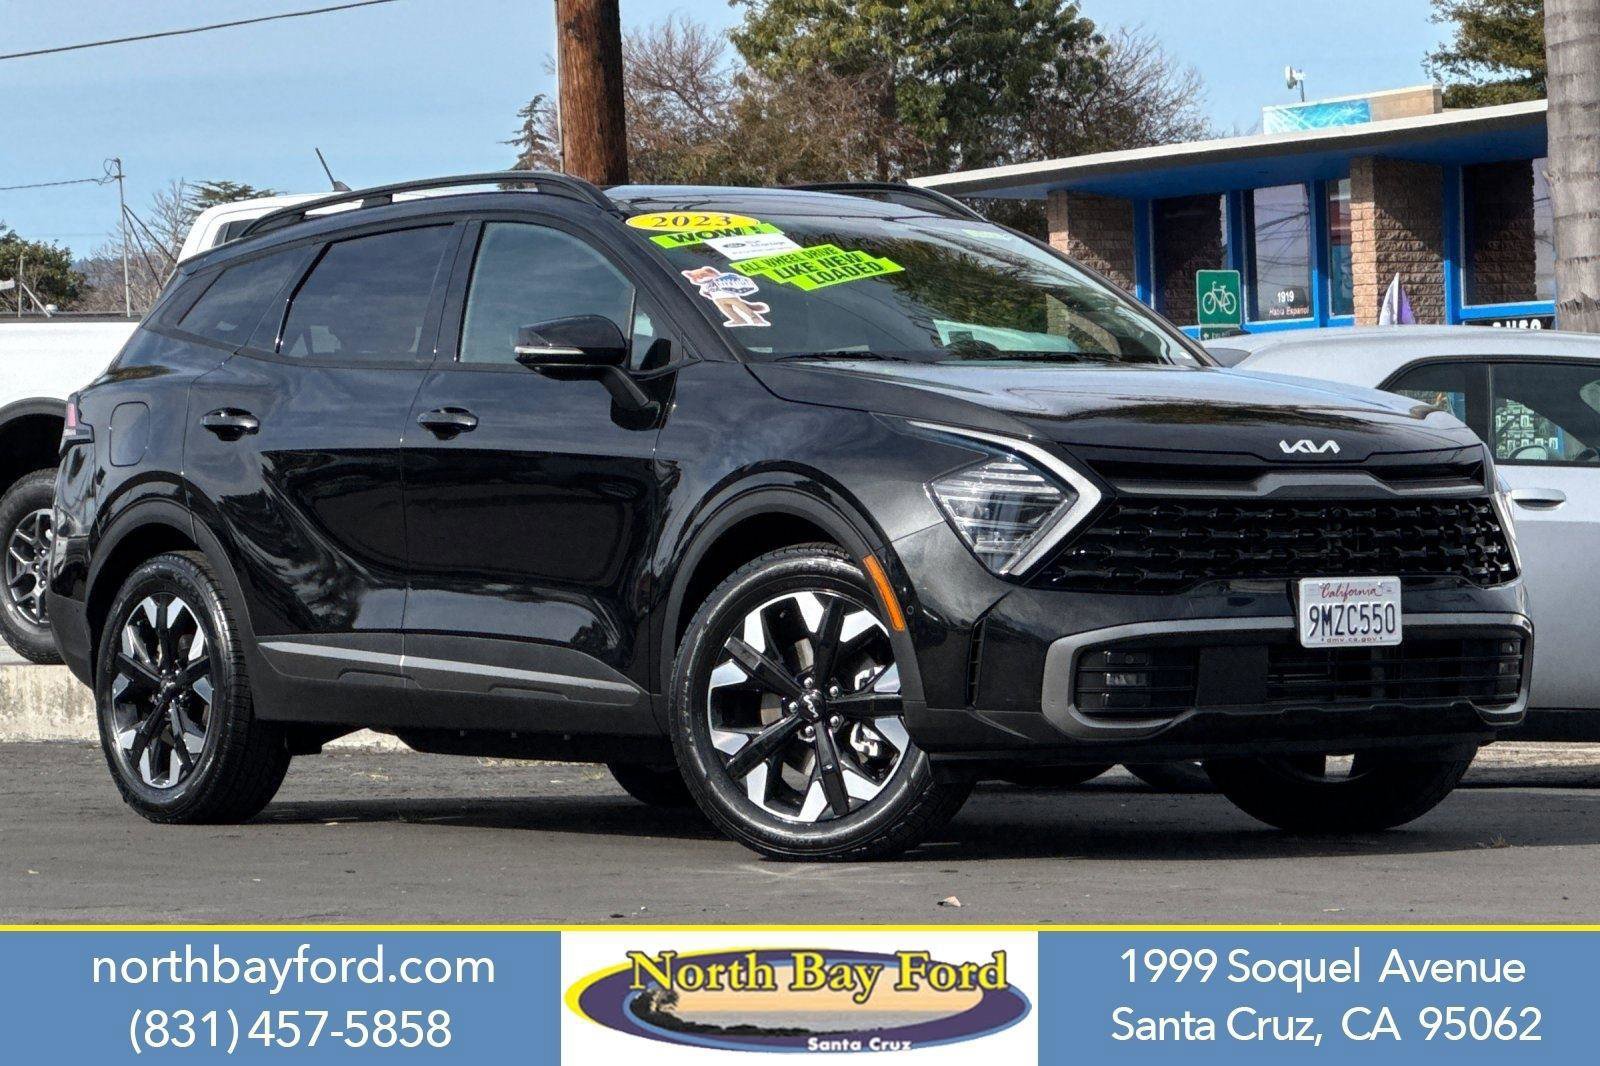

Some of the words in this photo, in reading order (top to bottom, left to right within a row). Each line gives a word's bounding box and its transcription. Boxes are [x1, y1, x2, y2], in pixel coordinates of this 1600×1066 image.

[651, 215, 732, 228] 2023
[739, 260, 765, 273] ALL
[763, 251, 803, 268] WHEEL
[801, 246, 837, 260] DRIVE
[773, 261, 817, 280] LIKE
[817, 252, 863, 269] NEW
[808, 260, 885, 285] LOADED
[1277, 289, 1295, 304] 1919
[1320, 582, 1382, 603] California
[1308, 602, 1396, 637] 9MZC550
